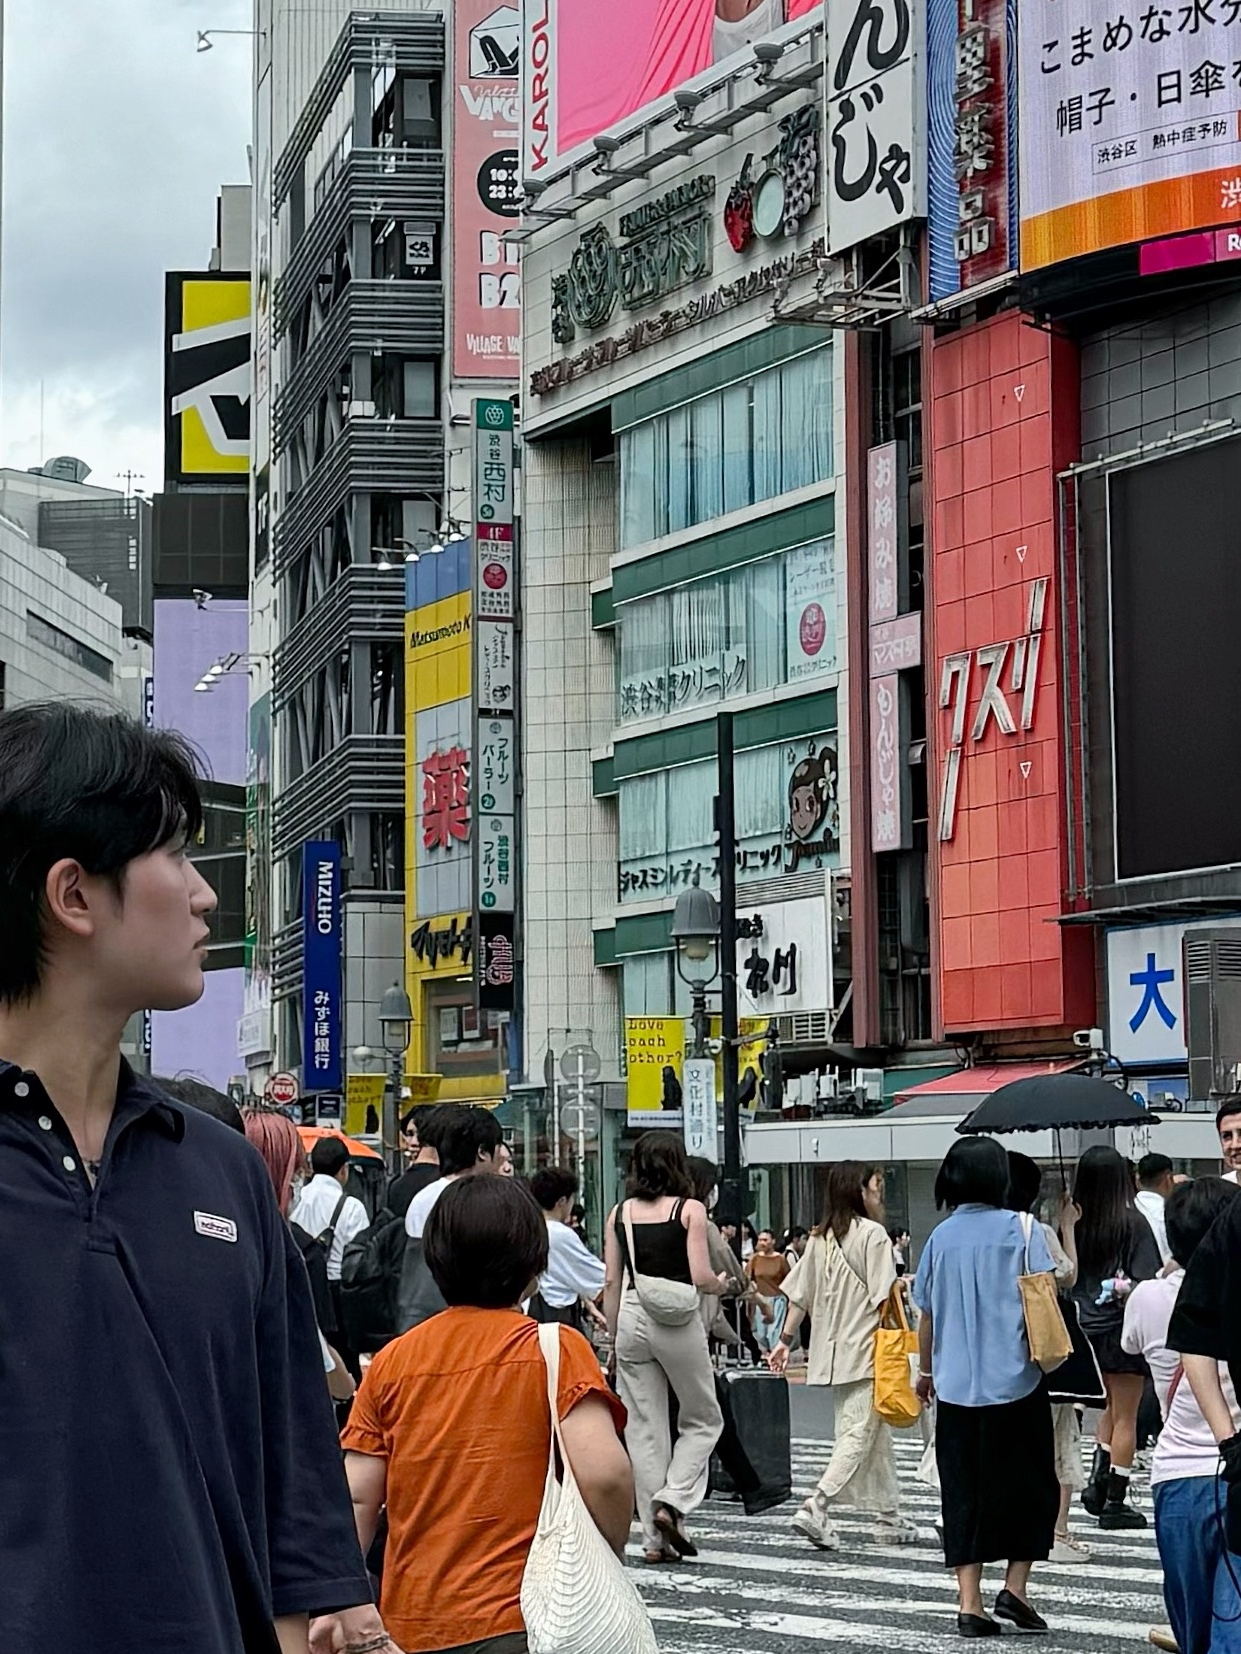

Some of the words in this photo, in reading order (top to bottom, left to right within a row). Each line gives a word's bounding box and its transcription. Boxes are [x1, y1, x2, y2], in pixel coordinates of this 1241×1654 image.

[1097, 139, 1138, 164] 渋谷区
[1152, 120, 1228, 150] 熱中症予防
[1228, 233, 1241, 252] R
[466, 333, 503, 355] VILLAGE
[937, 576, 1050, 842] クスリ
[497, 738, 509, 784] フルーツ
[422, 747, 471, 850] 薬
[483, 841, 495, 889] フルーツ
[620, 844, 782, 892] ジャスミンレディースリニック
[317, 861, 334, 934] MIZUHO
[314, 991, 330, 1069] みずほ銀行
[628, 1018, 664, 1031] Love
